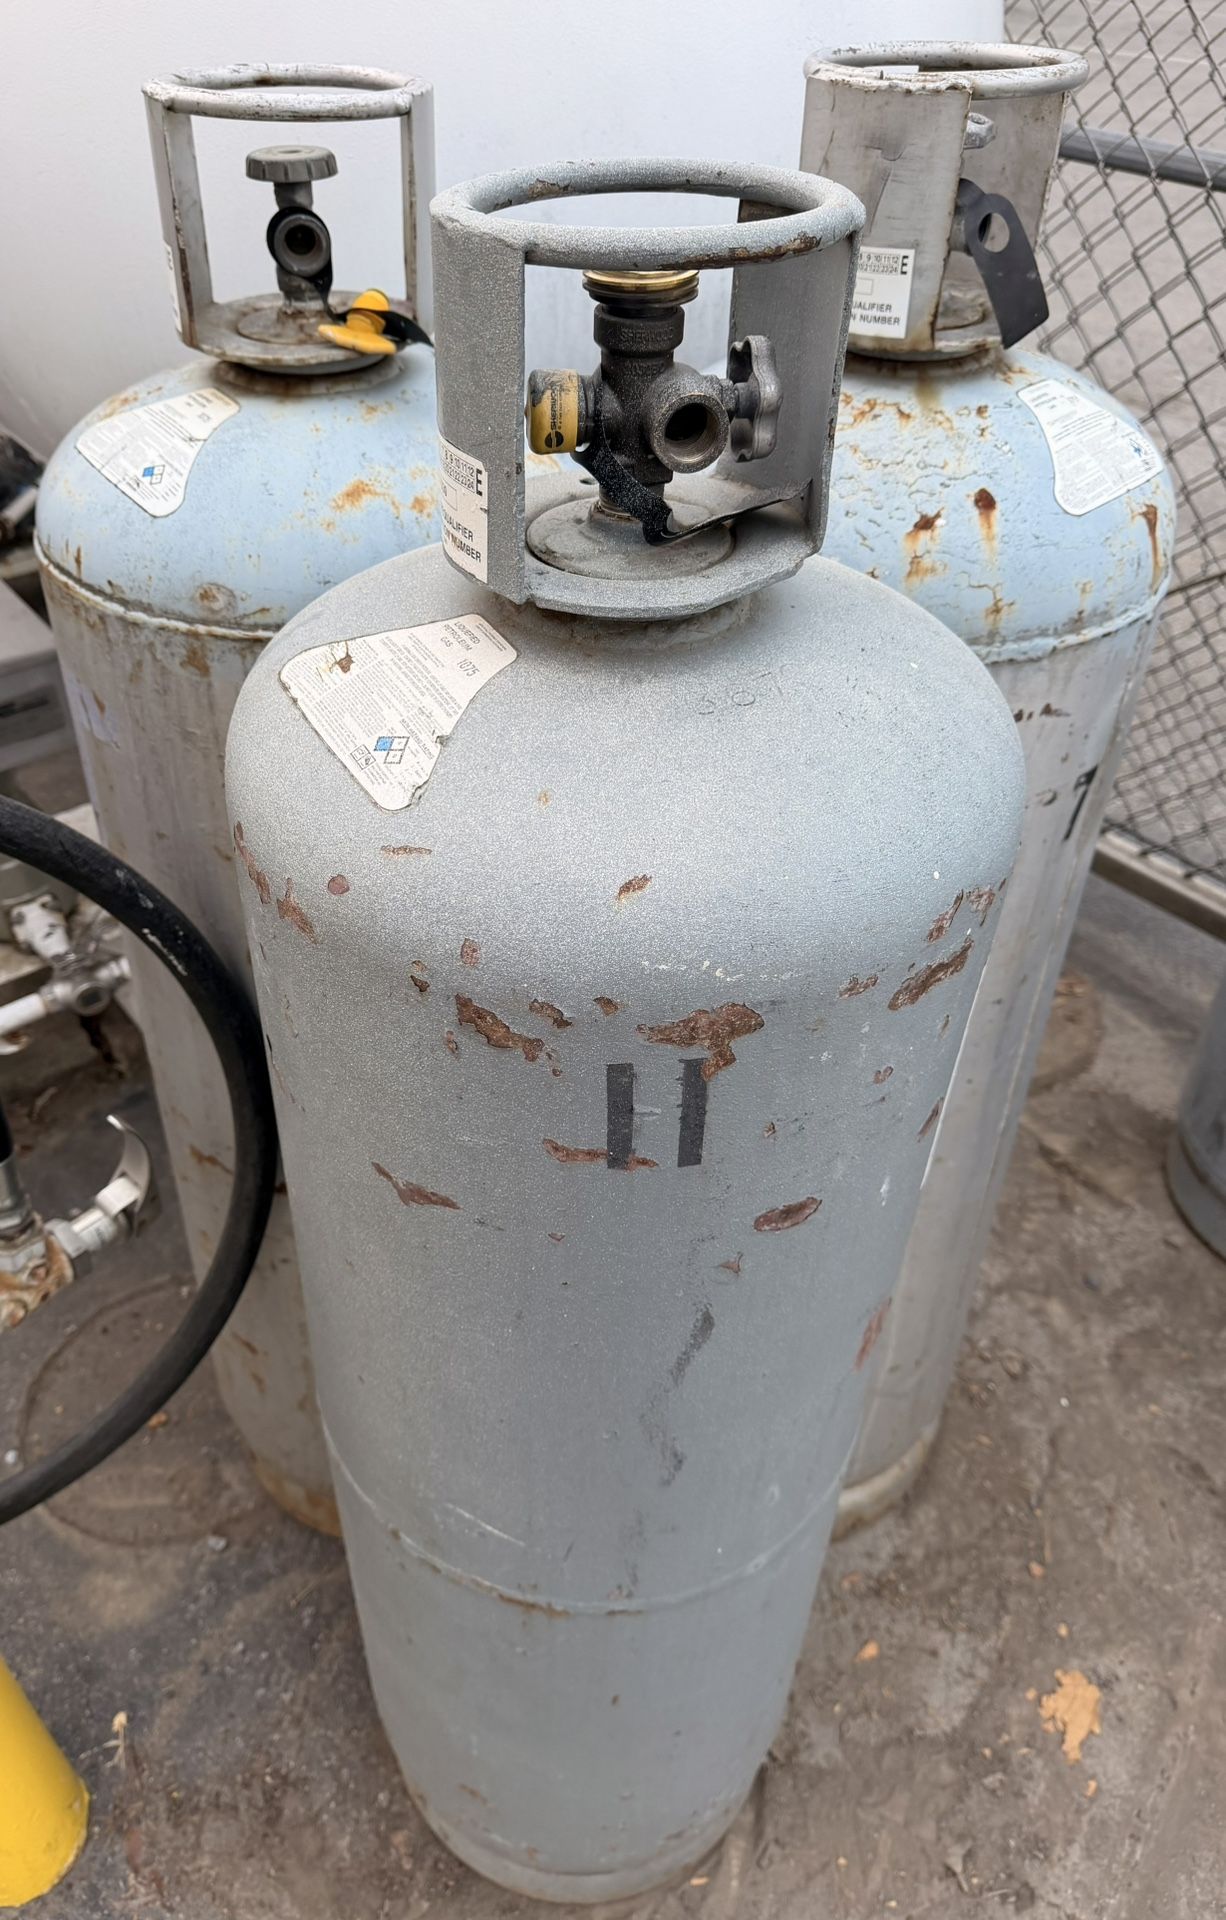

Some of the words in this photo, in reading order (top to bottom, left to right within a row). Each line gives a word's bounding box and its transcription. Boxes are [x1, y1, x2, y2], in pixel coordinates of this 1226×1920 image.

[900, 255, 909, 275] E
[859, 314, 901, 326] NUMBER
[475, 467, 483, 496] E
[456, 659, 480, 677] 1075
